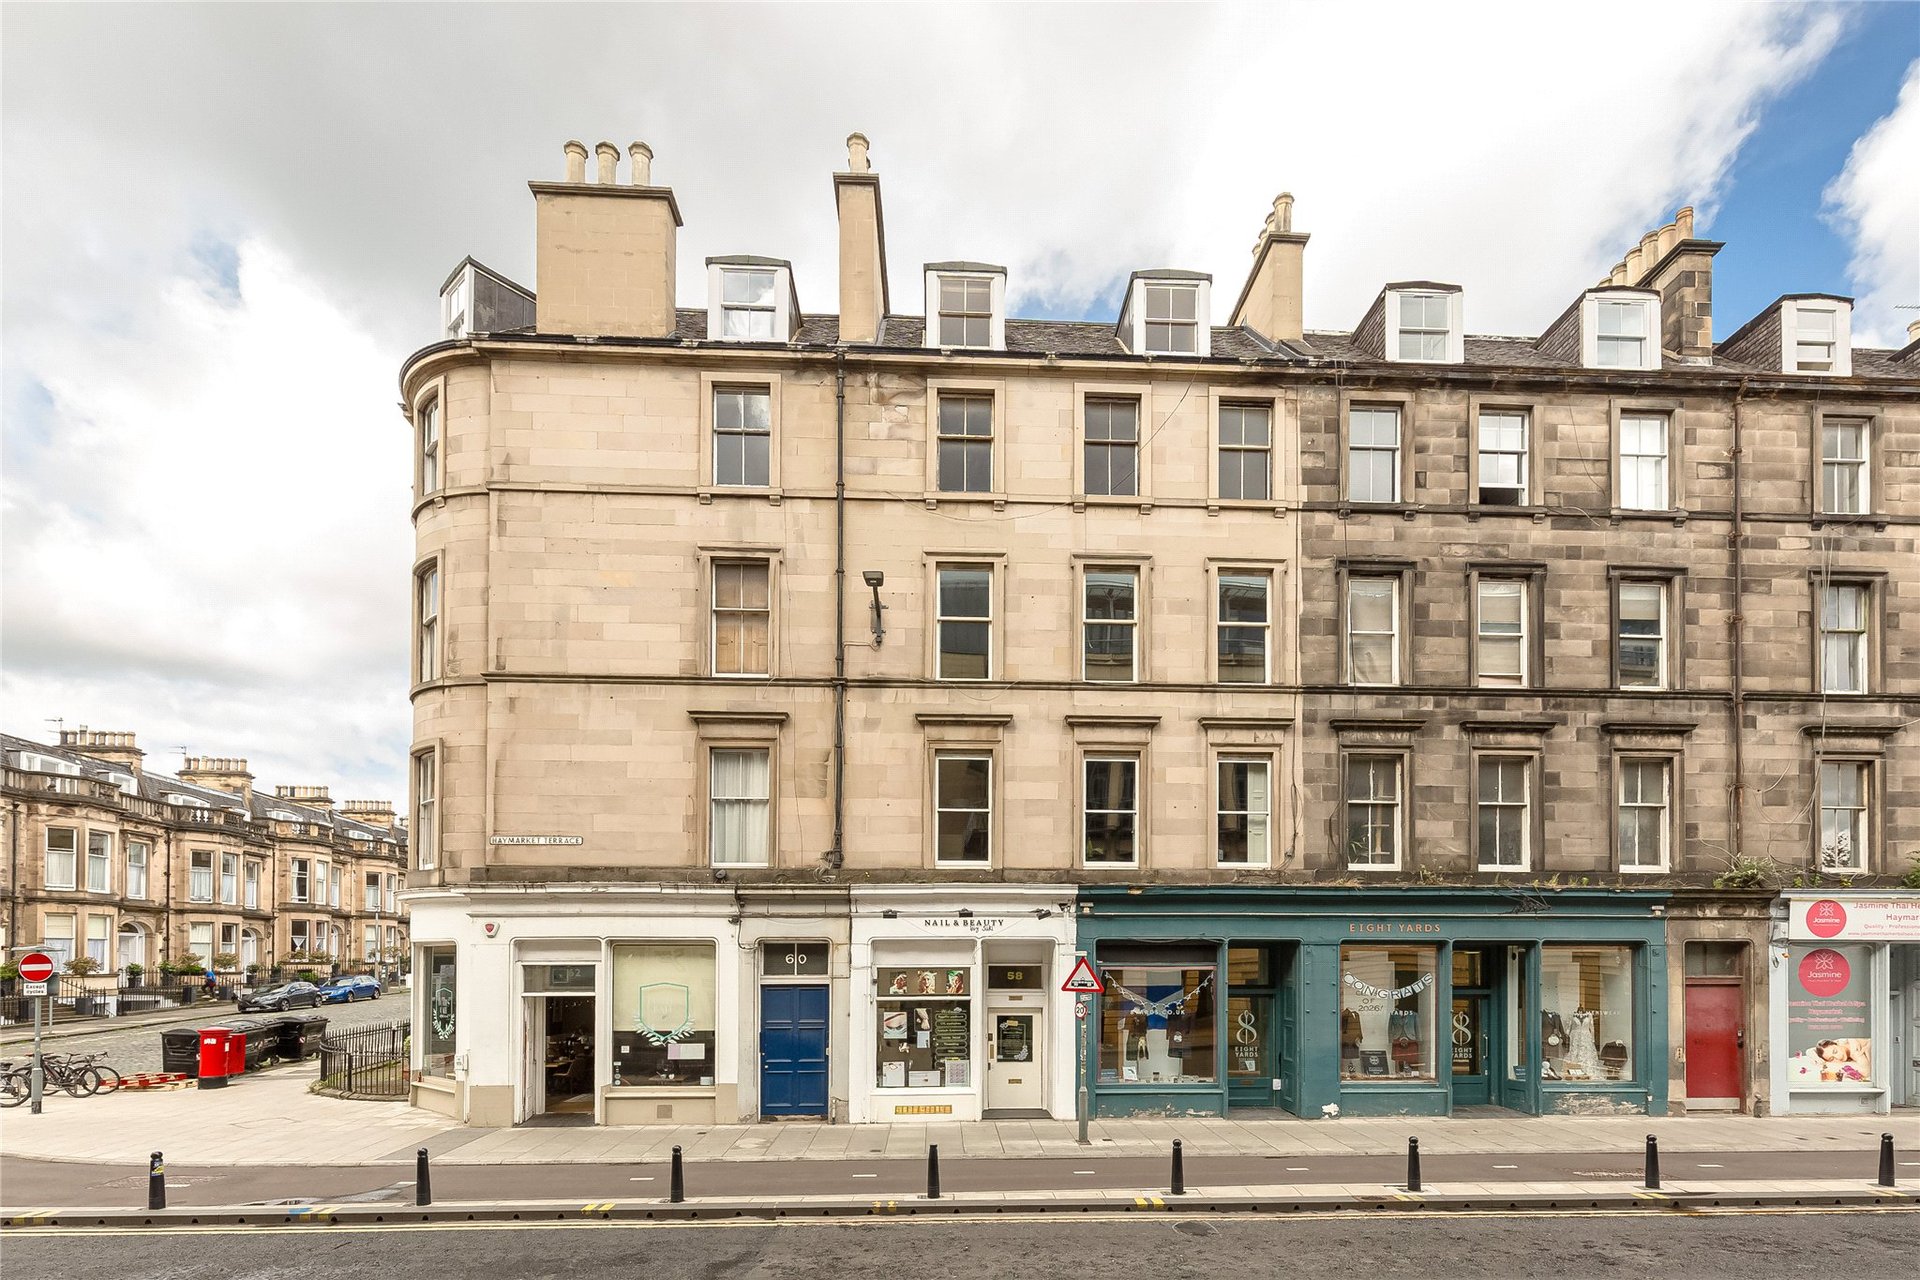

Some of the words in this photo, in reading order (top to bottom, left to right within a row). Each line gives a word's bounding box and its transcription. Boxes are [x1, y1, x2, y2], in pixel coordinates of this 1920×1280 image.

[1854, 902, 1888, 910] Jasmine
[1349, 923, 1392, 932] EIGHT
[1399, 923, 1440, 932] YARDS
[785, 953, 807, 964] 60
[1007, 971, 1023, 980] 58
[1343, 972, 1434, 999] CONGRATS
[1076, 1005, 1084, 1014] 20
